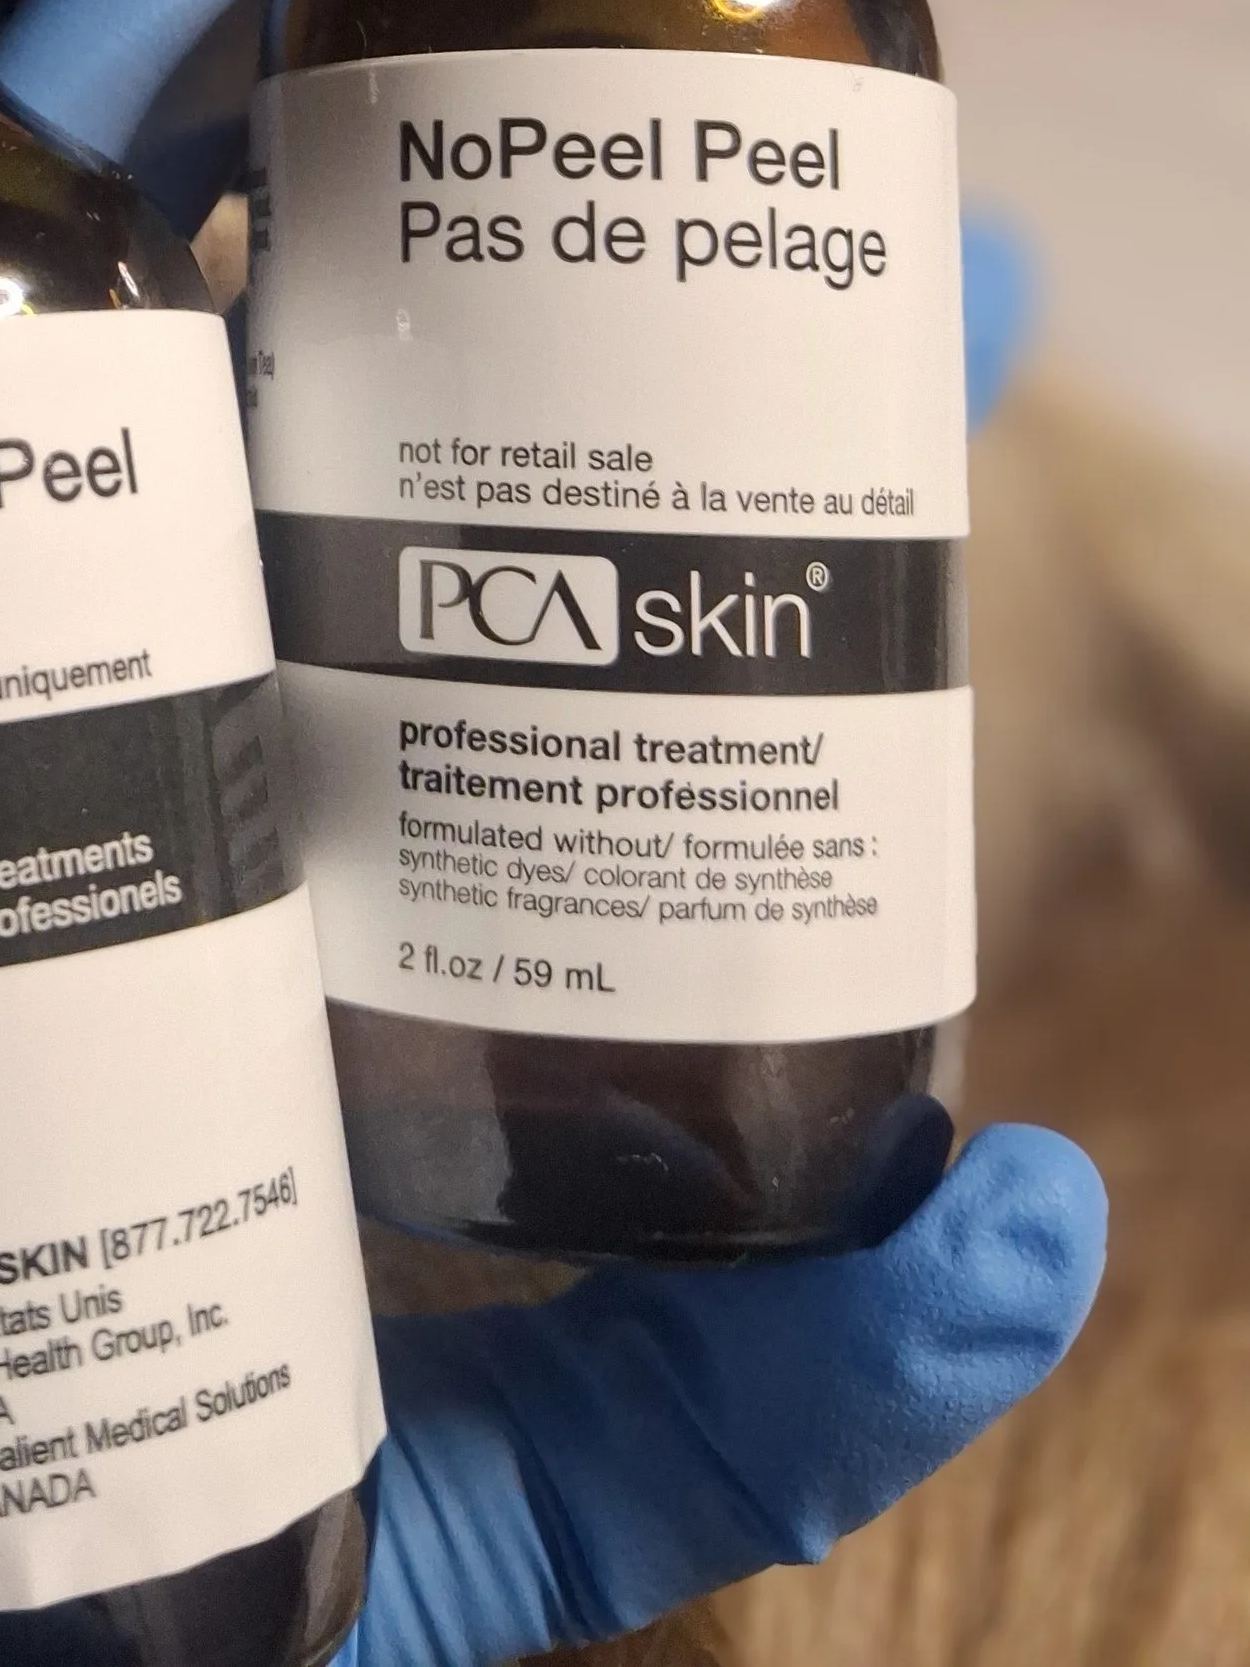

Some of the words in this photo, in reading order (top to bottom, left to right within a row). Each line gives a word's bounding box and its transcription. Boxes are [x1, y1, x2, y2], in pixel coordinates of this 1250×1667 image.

[398, 117, 663, 182] NoPeel
[694, 119, 841, 191] Peel
[400, 200, 525, 263] Pas
[550, 200, 647, 264] de
[675, 206, 888, 291] pelage
[398, 439, 442, 466] not
[451, 437, 491, 467] for
[500, 440, 577, 470] retail
[588, 443, 653, 472] sale
[476, 480, 532, 509] pas
[542, 477, 661, 511] destiné
[671, 480, 690, 511] à
[701, 482, 727, 513] la
[736, 487, 815, 515] vente
[824, 492, 854, 516] au
[861, 485, 915, 517] détail
[418, 558, 603, 651] PCA
[398, 717, 621, 762] professional
[633, 732, 825, 766] treatment/
[398, 759, 584, 806] traitement
[398, 810, 543, 852] formulated
[552, 828, 675, 861] without/
[683, 833, 805, 861] formulée
[398, 845, 499, 879] synthetic
[507, 860, 576, 887] dyes/
[584, 864, 686, 891] colorant
[695, 867, 727, 891] de
[735, 866, 833, 896] synthèse
[398, 875, 499, 909] synthetic
[507, 885, 651, 920] fragrances/
[658, 896, 747, 925] parfum
[755, 898, 785, 922] de
[792, 893, 878, 926] synthèse
[398, 941, 416, 972] 2
[424, 945, 484, 981] fl.oz
[513, 956, 553, 990] 59
[565, 962, 617, 994] mL
[59, 1285, 125, 1325] Unis
[92, 1316, 182, 1363] Group,
[186, 1299, 230, 1329] Inc.
[85, 1401, 189, 1451] Medical
[195, 1362, 293, 1423] Solutions
